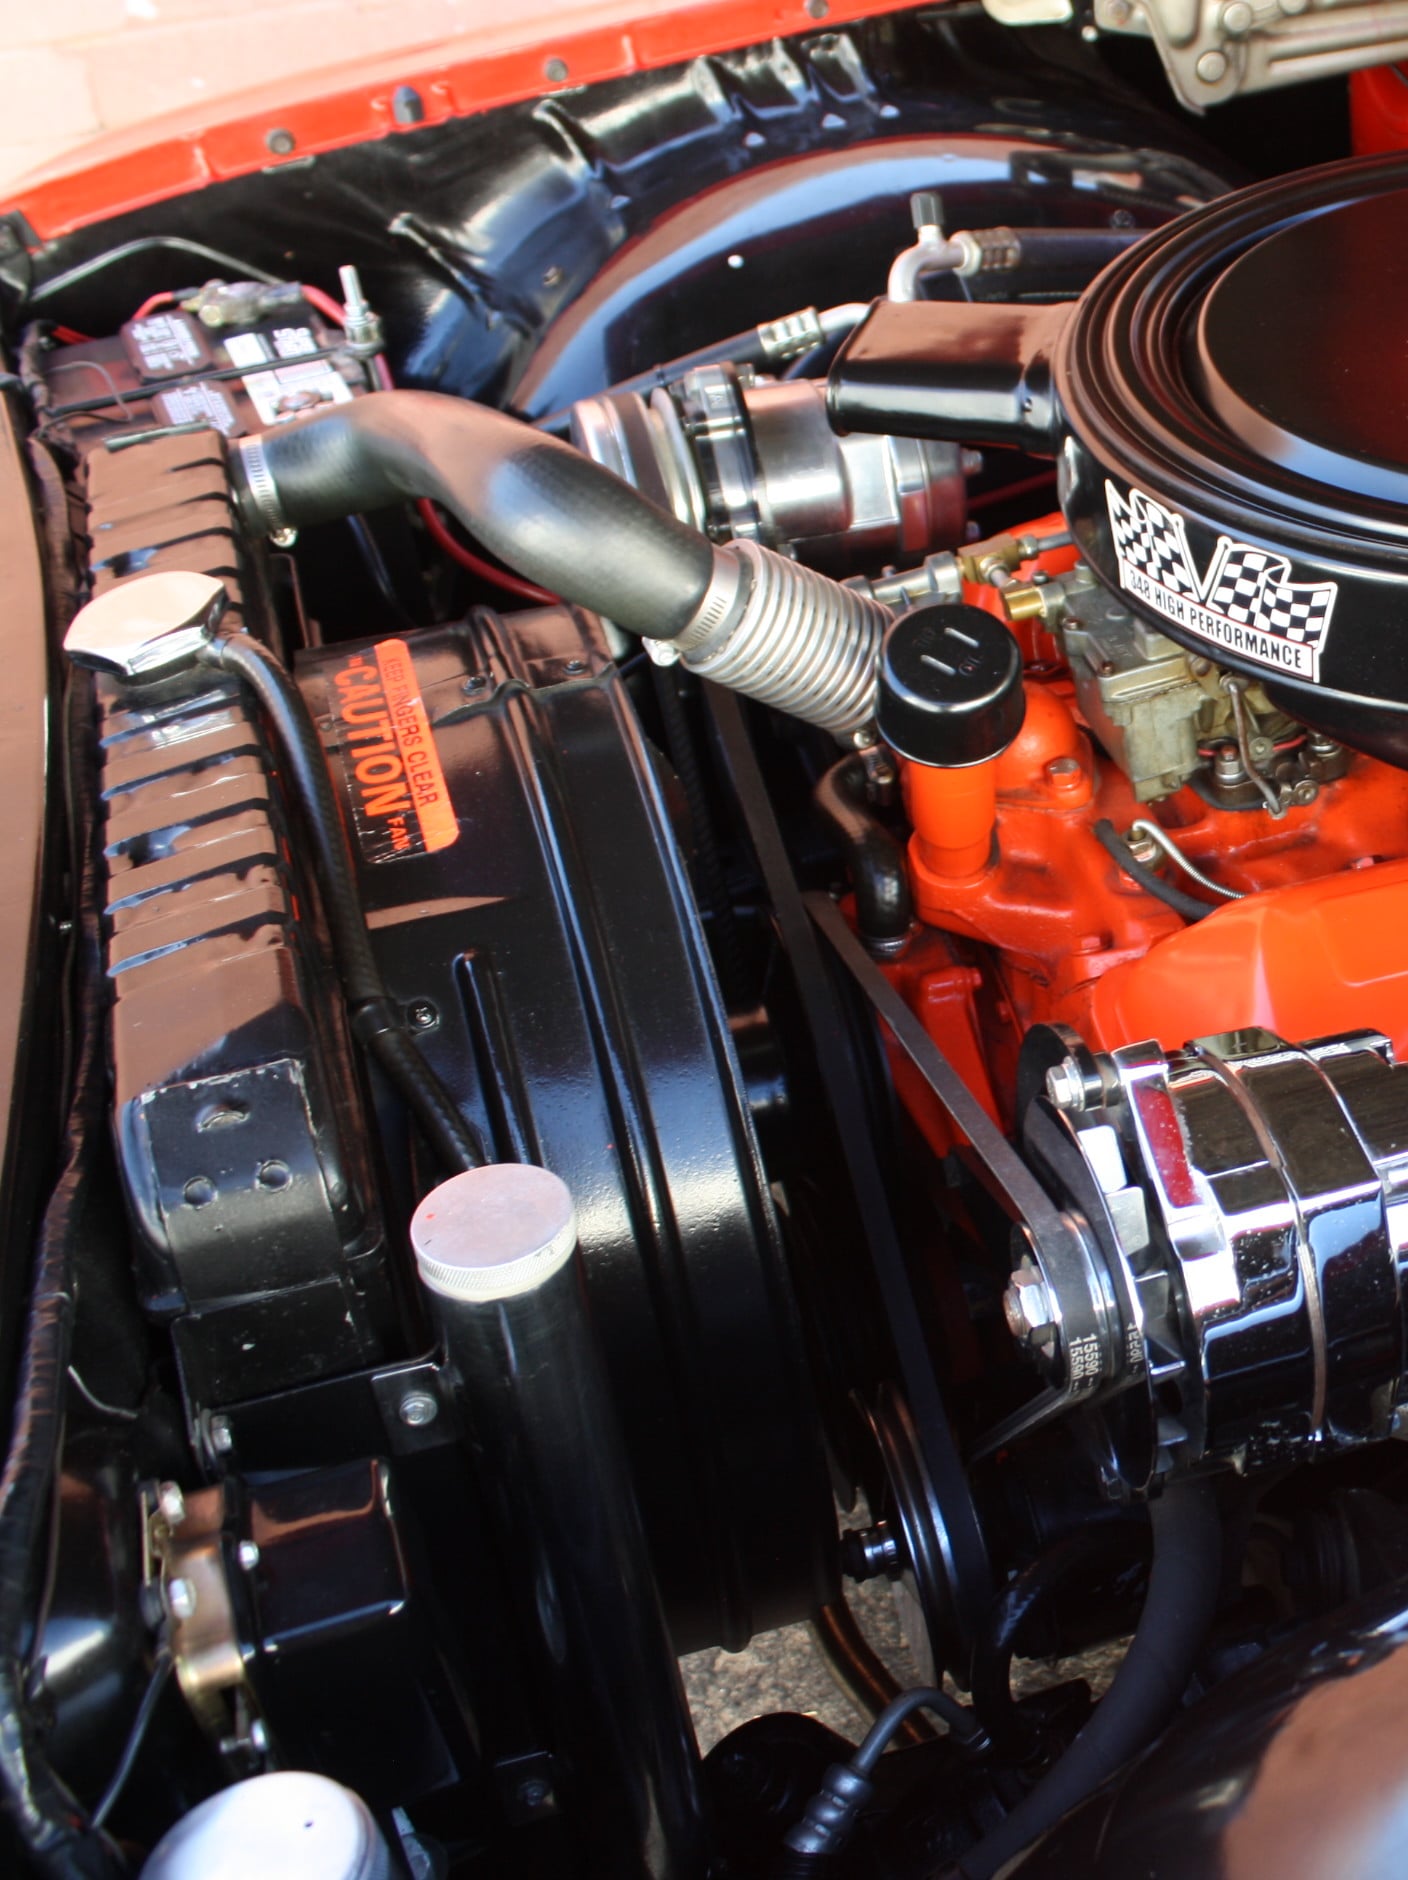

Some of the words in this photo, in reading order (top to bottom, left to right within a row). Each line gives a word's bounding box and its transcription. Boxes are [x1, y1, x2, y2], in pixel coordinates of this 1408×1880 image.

[1130, 569, 1151, 600] 348
[1155, 583, 1184, 620] HIGH
[1190, 607, 1302, 669] PERFORMANCE
[382, 658, 402, 689] KEEP
[390, 687, 422, 747] FINGERS
[334, 664, 412, 817] CAUTION
[386, 816, 411, 851] FAN
[408, 749, 439, 807] CLEAR
[1083, 1333, 1099, 1376] 15590
